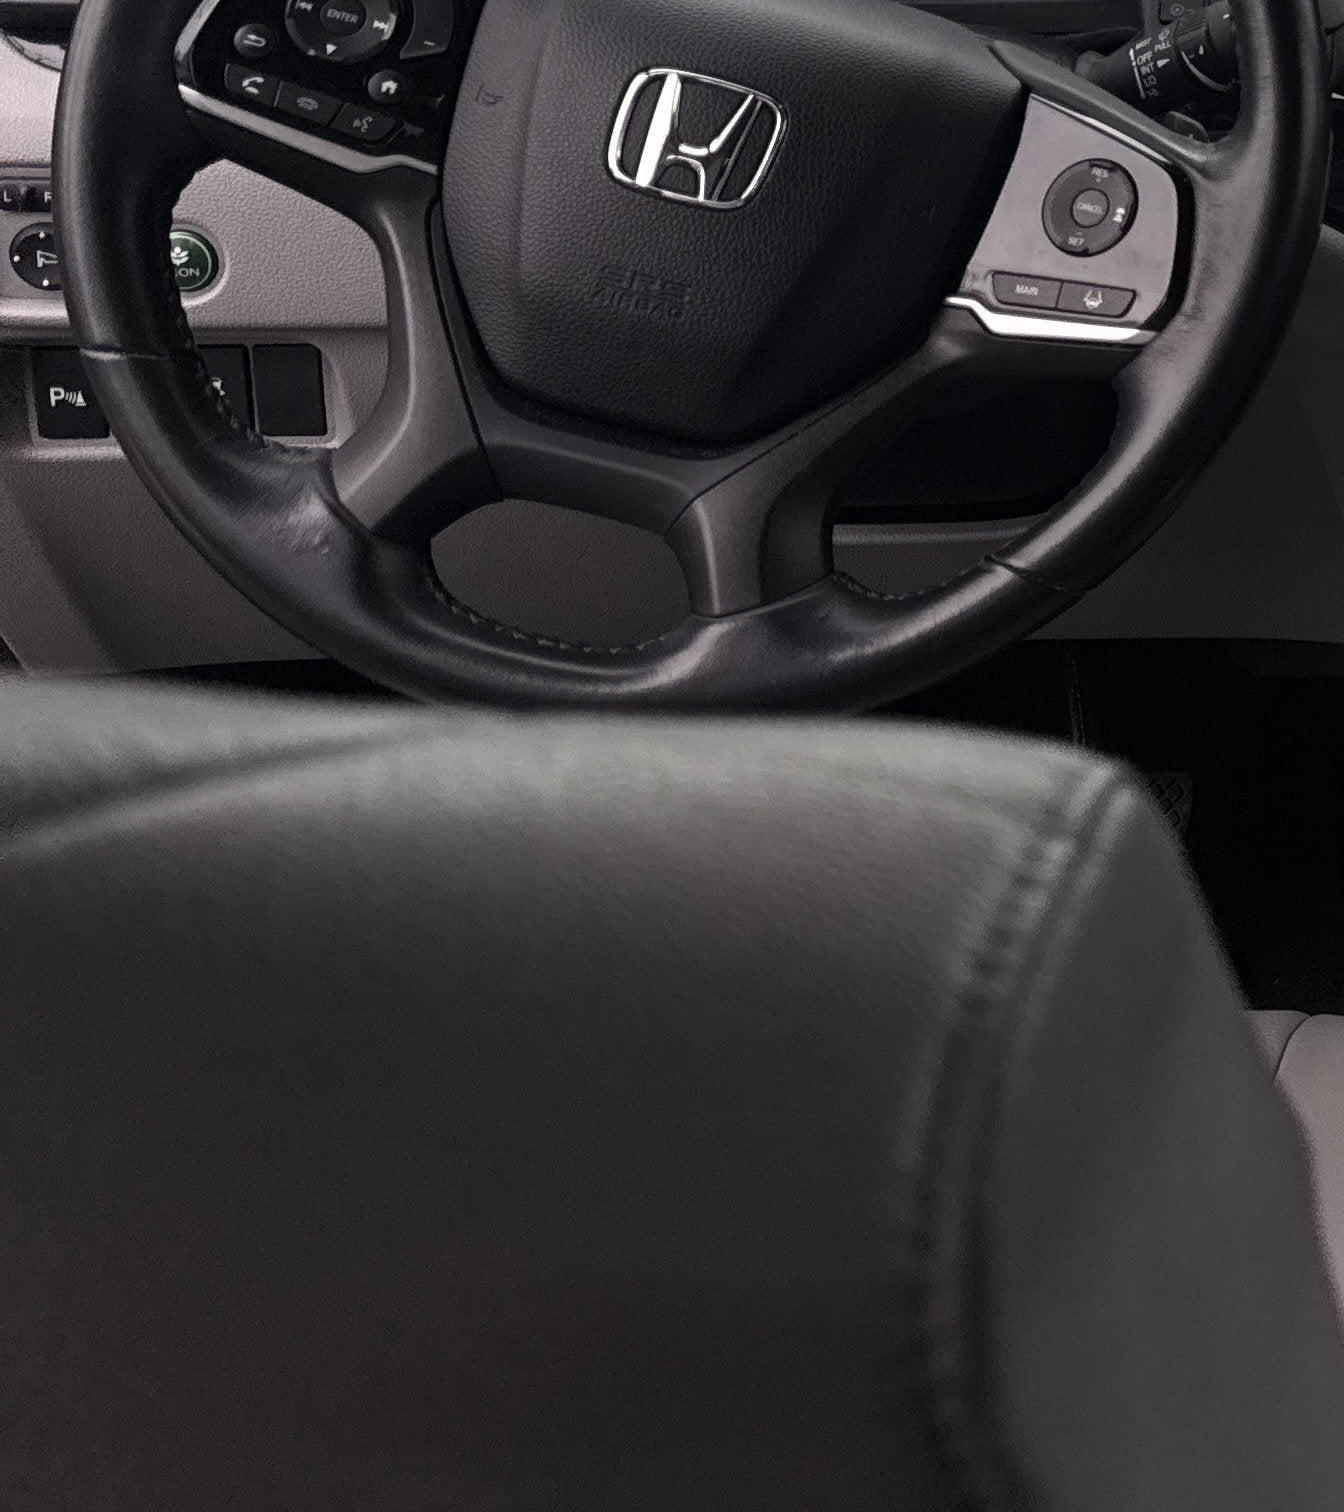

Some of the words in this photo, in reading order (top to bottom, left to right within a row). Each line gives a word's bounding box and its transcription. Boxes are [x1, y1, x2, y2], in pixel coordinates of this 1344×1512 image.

[326, 8, 359, 25] ENTER
[1137, 51, 1153, 66] OFF
[3, 190, 12, 203] L
[1067, 235, 1085, 249] SET
[1015, 283, 1039, 297] MAIN
